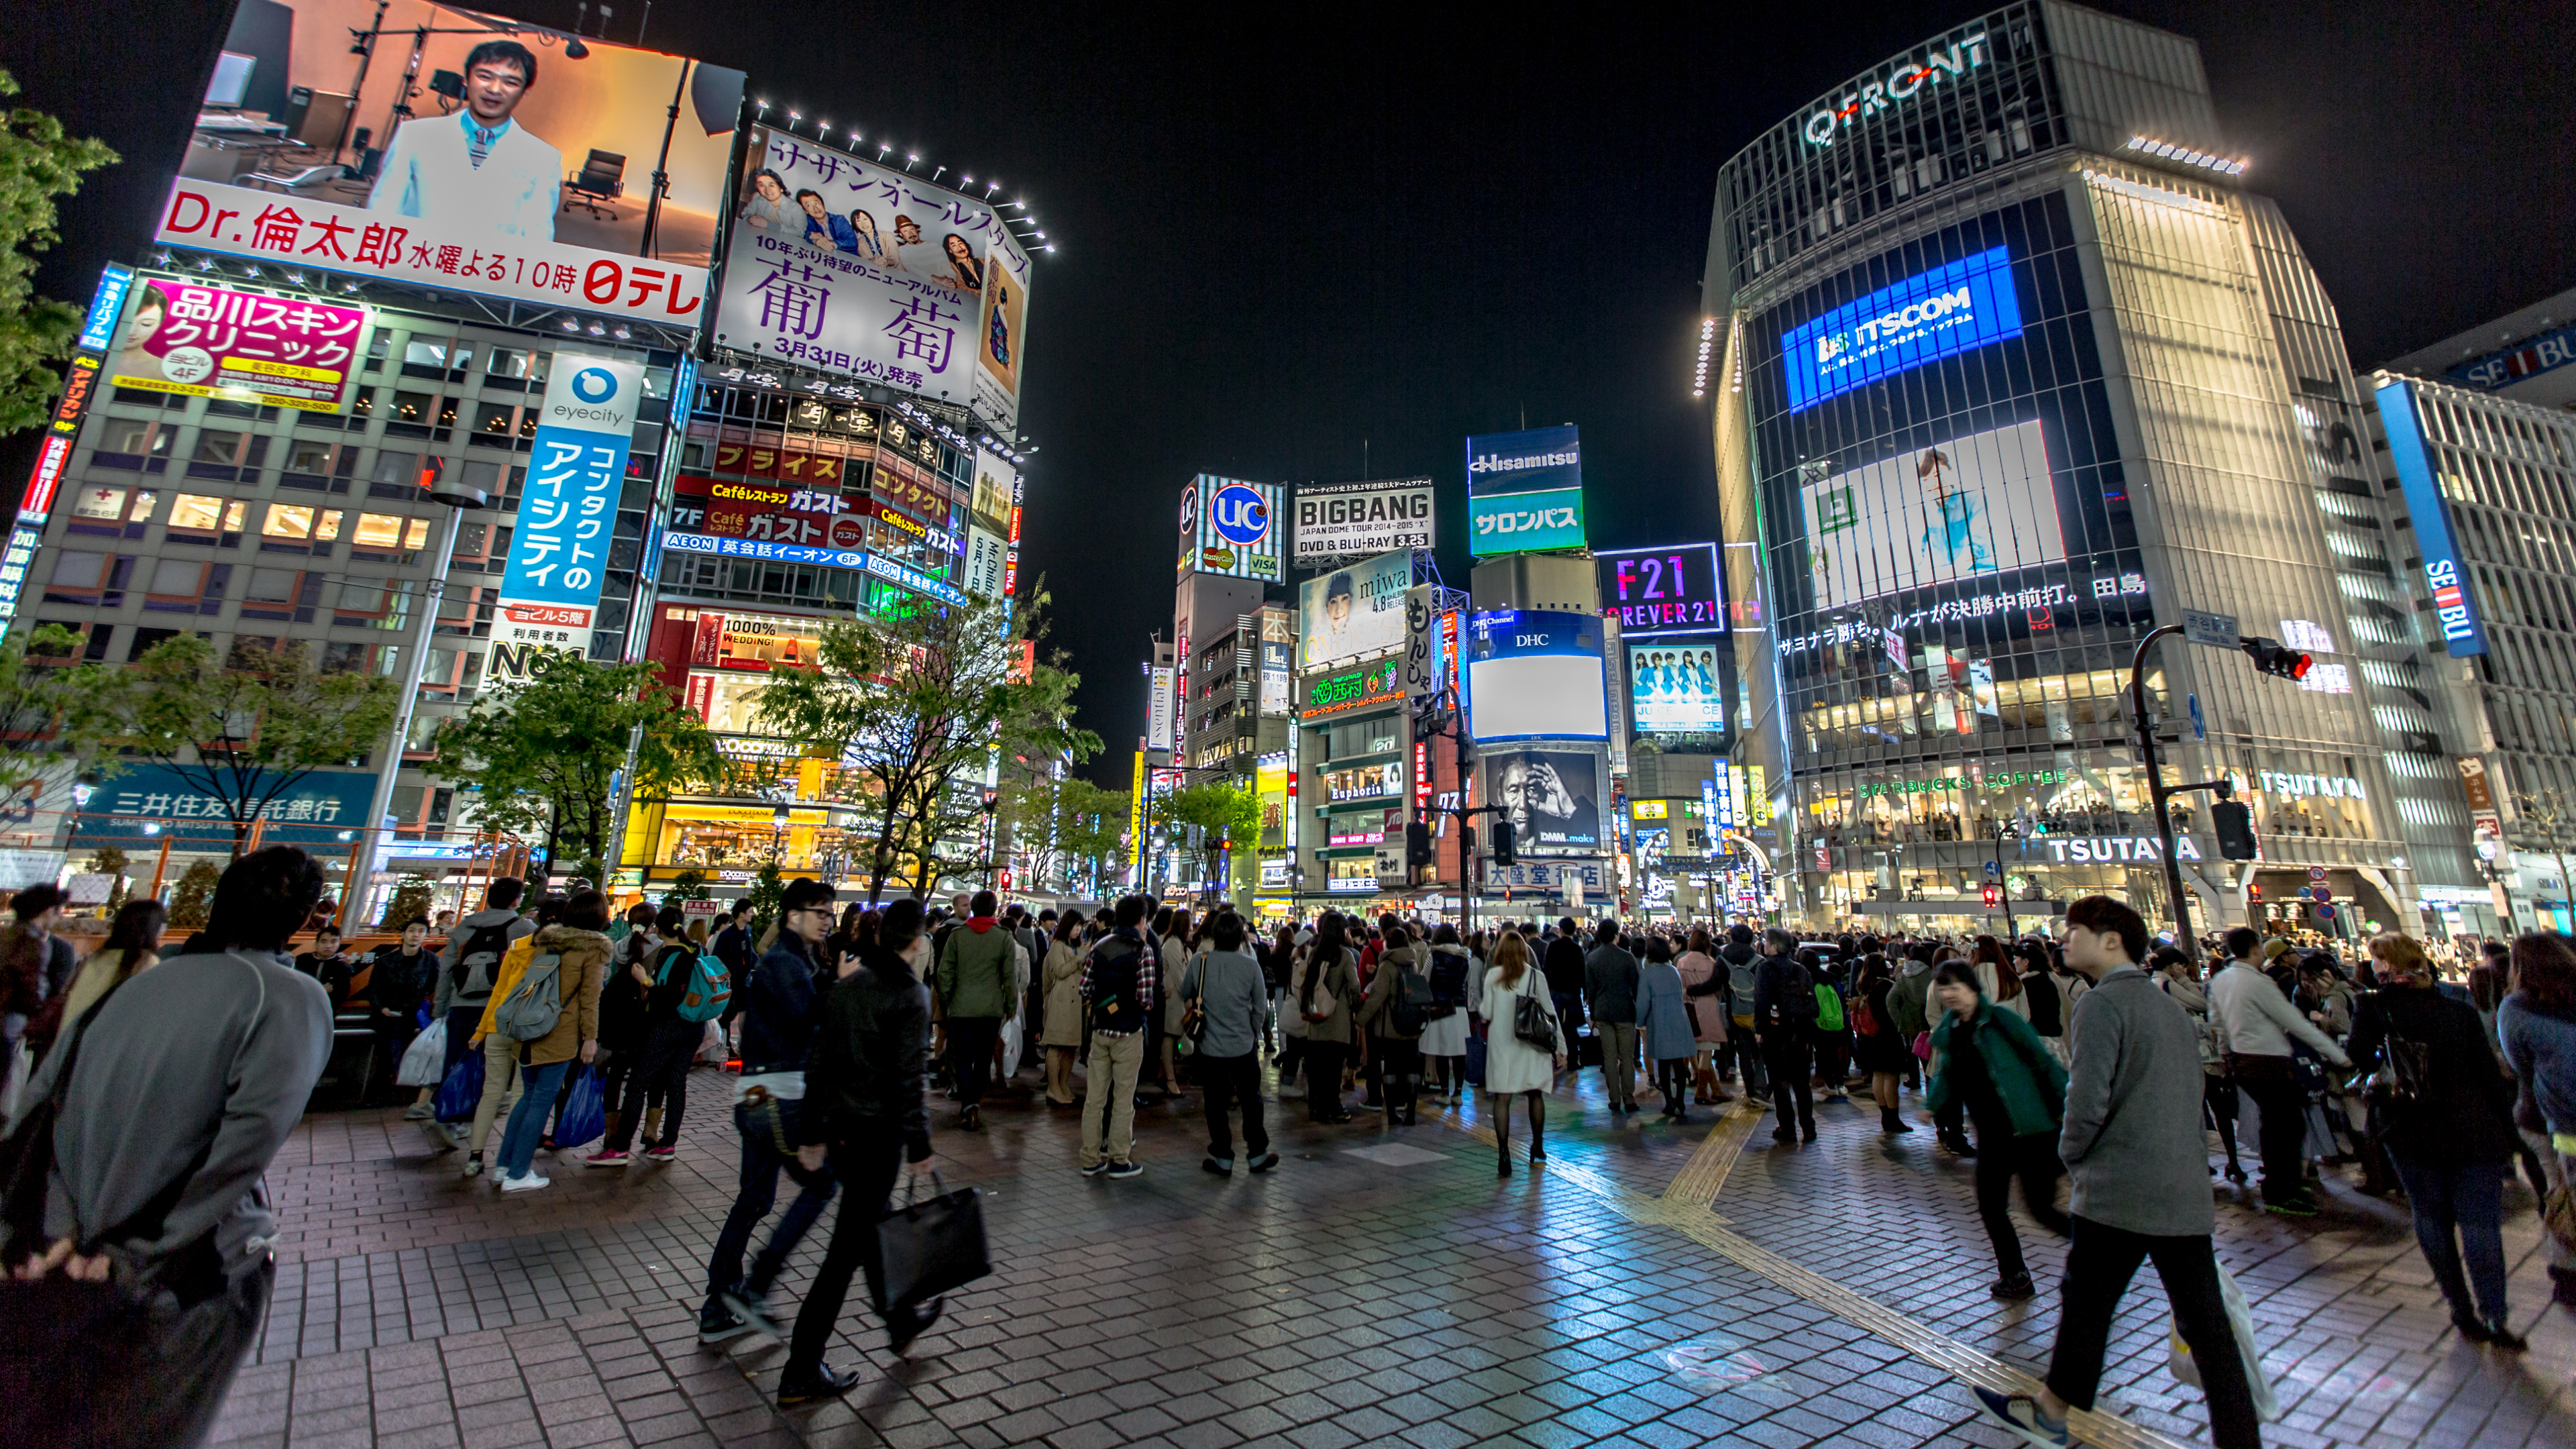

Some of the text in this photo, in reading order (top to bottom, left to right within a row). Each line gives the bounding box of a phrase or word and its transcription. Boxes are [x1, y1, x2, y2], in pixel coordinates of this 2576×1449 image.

[1806, 32, 1984, 146] QFRONT
[770, 140, 1028, 284] サザンオールスターズ
[166, 191, 577, 294] Dr.倫太郎 水曜よる10時
[756, 234, 962, 306] 10年ぶり待望のニューアルバム
[170, 288, 359, 337] 品川スキン
[165, 320, 350, 366] クリニック
[171, 368, 199, 379] 4F
[554, 405, 625, 427] eyecity
[719, 445, 837, 480] プライス
[1469, 452, 1578, 472] Hisamitsu
[790, 490, 850, 515] ガスト
[875, 468, 948, 517] コンタクト
[522, 441, 582, 588] アイシティ
[564, 447, 614, 590] コンタクトの
[674, 508, 703, 525] 7F
[710, 511, 744, 526] Café
[1300, 494, 1428, 527] BIGBANG
[1476, 507, 1578, 535] サロンパス
[710, 524, 743, 535] レストラン
[746, 514, 822, 543] ガスト
[926, 527, 961, 555] ガスト
[1300, 526, 1327, 536] JAPAN
[1328, 525, 1350, 534] DOME
[1352, 524, 1373, 533] TOUR
[668, 533, 858, 566] AEON 英会話イーオン 6F
[1300, 534, 1426, 553] DVD & BLU-RAY 3.25
[871, 558, 898, 578] AEON
[985, 541, 1000, 600] Mr.Childre
[1202, 553, 1235, 564] MasterCard
[1252, 559, 1277, 571] VISA
[1360, 570, 1407, 600] miwa
[1617, 555, 1685, 601] F21
[2092, 574, 2146, 599] 田島
[1373, 595, 1387, 614] 4.8
[2425, 559, 2473, 642] SEIBU
[514, 606, 586, 625] 当ビル5階
[1487, 614, 1515, 625] Channel
[1597, 601, 1715, 627] OREVER 21
[2188, 614, 2235, 636] 渋谷駅前
[513, 628, 569, 642] 利用者数
[723, 634, 774, 646] WEDDING!
[724, 620, 776, 635] 1000%
[1407, 598, 1431, 691] もんじゃ
[1516, 634, 1549, 647] DHC
[1609, 690, 1621, 734] neon
[1332, 784, 1382, 801] Euphoria
[1859, 768, 2068, 798] STARBUCKS COFFEE
[2259, 771, 2363, 800] TSUTAYA
[109, 818, 173, 828] SUMITO
[1386, 811, 1403, 828] JTB
[1540, 831, 1595, 843] DMM.make
